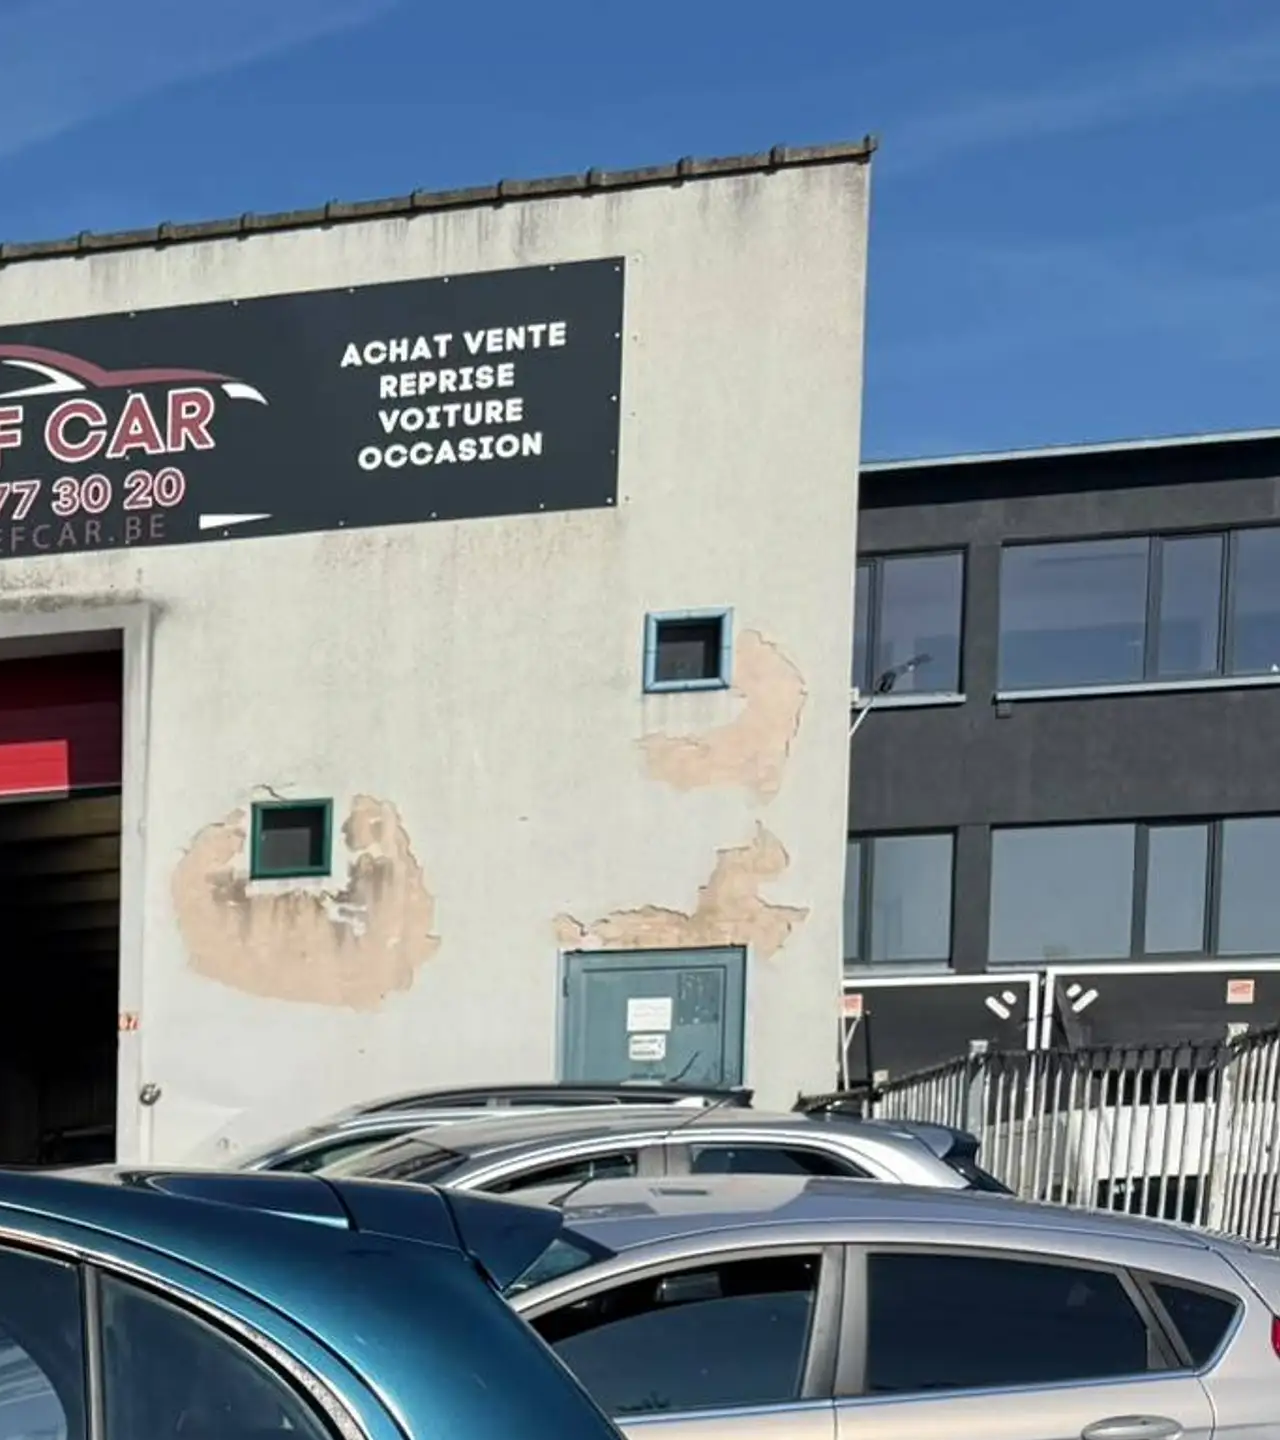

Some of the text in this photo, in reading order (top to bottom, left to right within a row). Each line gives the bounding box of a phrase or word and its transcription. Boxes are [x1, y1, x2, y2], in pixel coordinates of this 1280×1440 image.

[340, 321, 567, 368] ACHAT VENTE
[378, 362, 515, 399] REPRISE
[44, 387, 216, 463] CAR
[377, 397, 524, 434] VOITURE
[356, 431, 543, 471] OCCASION
[51, 474, 112, 517] 30
[123, 467, 186, 512] 20
